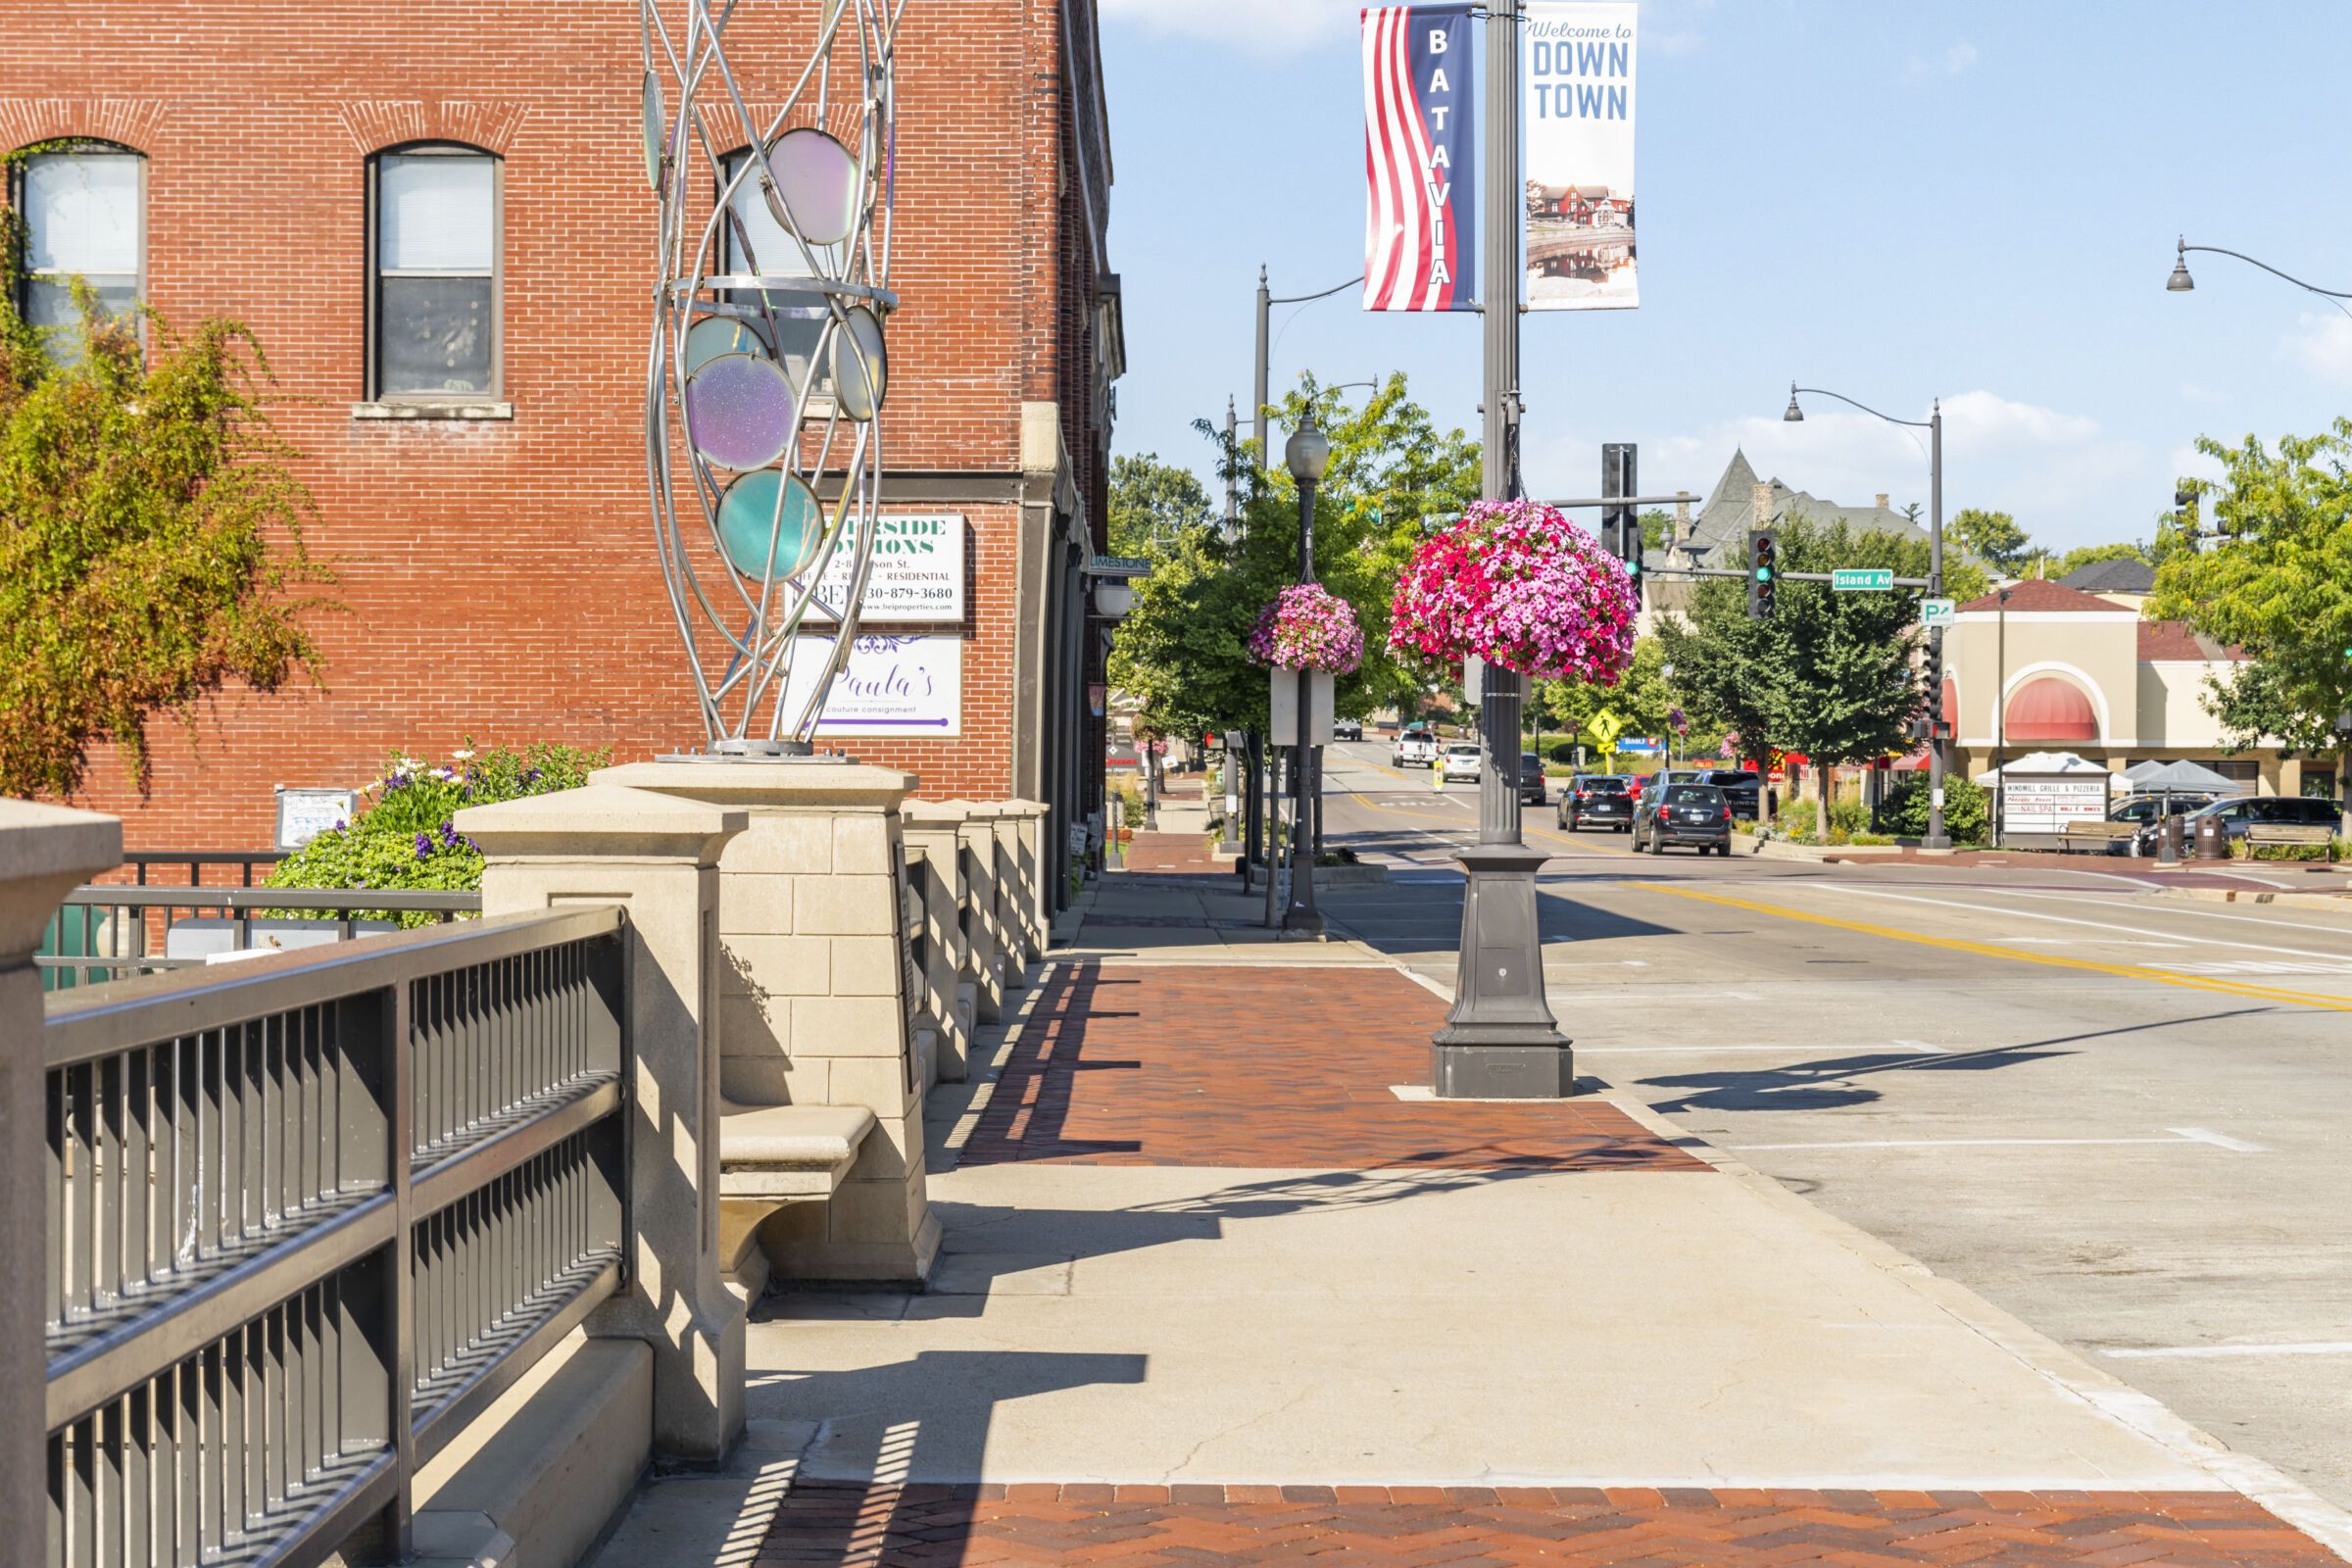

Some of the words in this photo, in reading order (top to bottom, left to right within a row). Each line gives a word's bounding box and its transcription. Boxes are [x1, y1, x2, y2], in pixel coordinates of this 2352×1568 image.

[1526, 22, 1612, 38] Welcome
[1615, 24, 1633, 38] to
[1534, 41, 1628, 77] DOWN
[1534, 83, 1627, 120] TOWN
[1429, 28, 1450, 285] BATAVIA
[825, 520, 946, 535] ERSIDE
[897, 560, 909, 568] St.
[1091, 556, 1152, 568] LIMESTONE
[1836, 574, 1871, 585] Island
[1877, 575, 1890, 585] Av
[867, 588, 953, 599] 30-879-3680
[1926, 605, 1939, 621] P
[821, 663, 932, 697] Paula's
